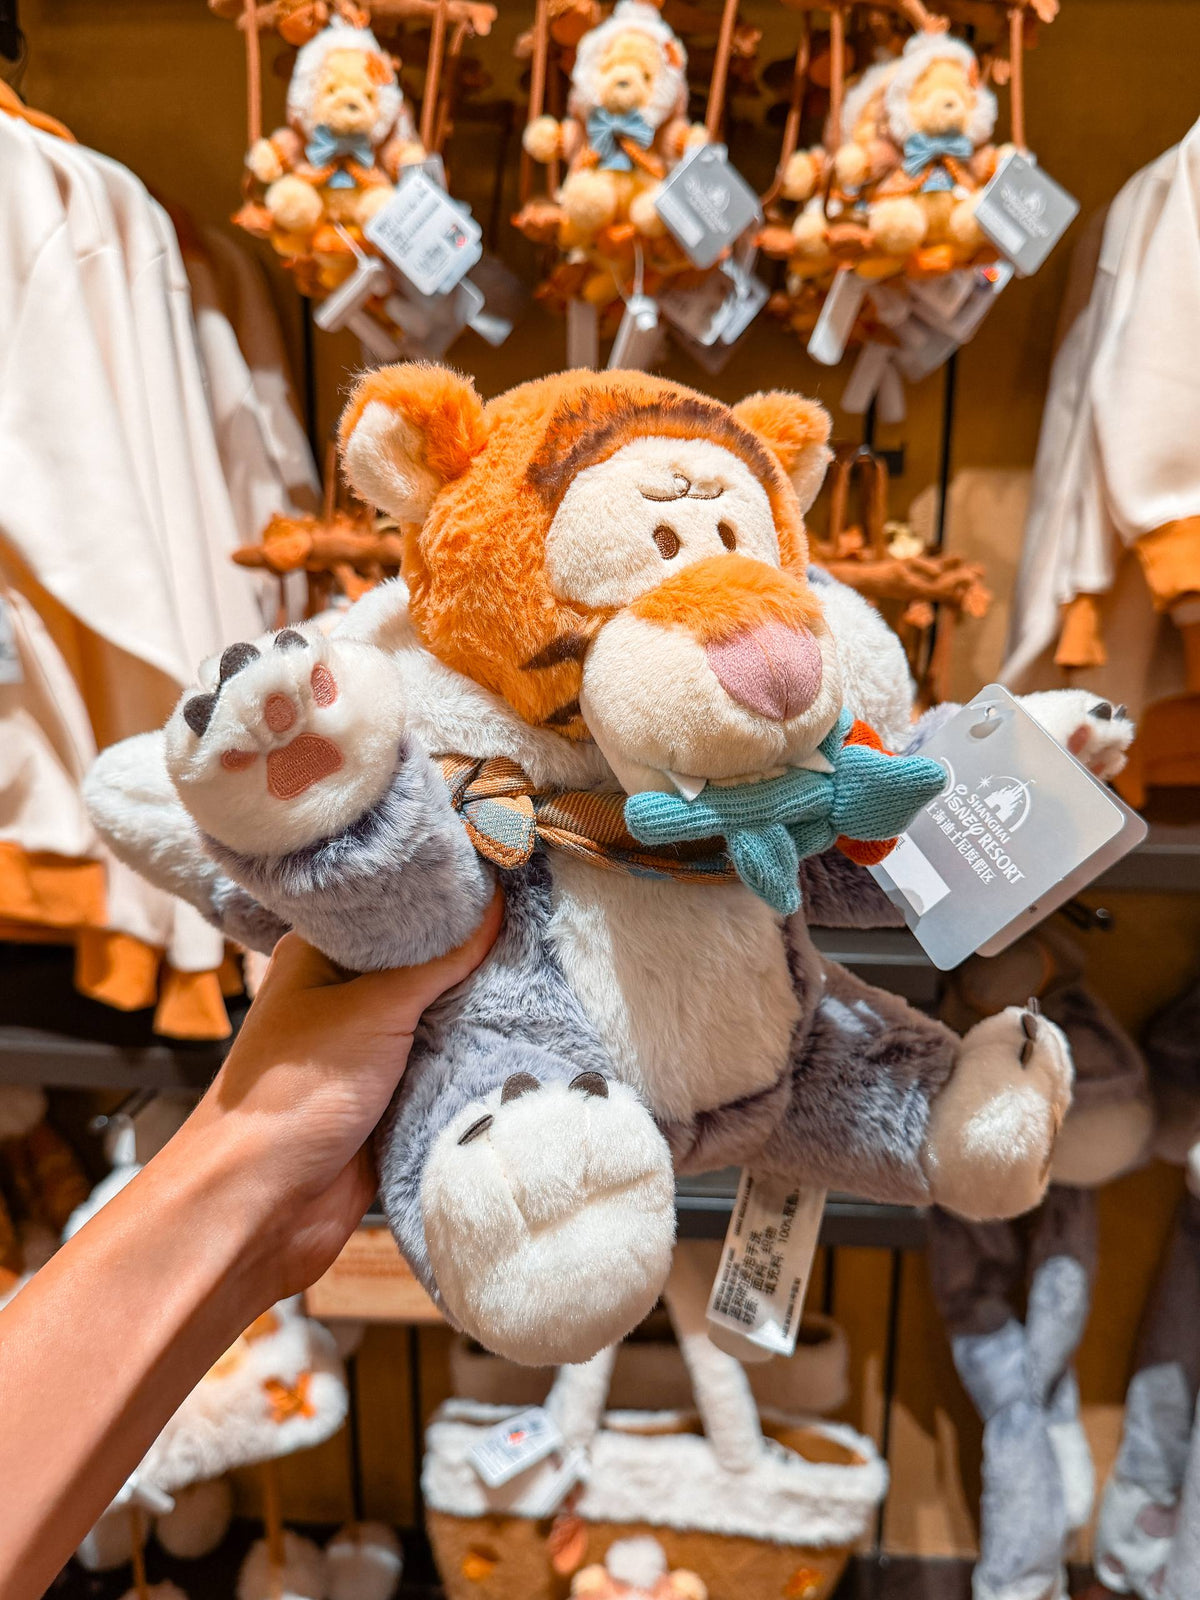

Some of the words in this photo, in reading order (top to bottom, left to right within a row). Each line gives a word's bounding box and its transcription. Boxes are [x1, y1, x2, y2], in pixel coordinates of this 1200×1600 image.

[925, 802, 997, 885] 上海迪士尼度假区
[966, 793, 1011, 844] SHANGHAI
[977, 833, 1026, 885] RESORT
